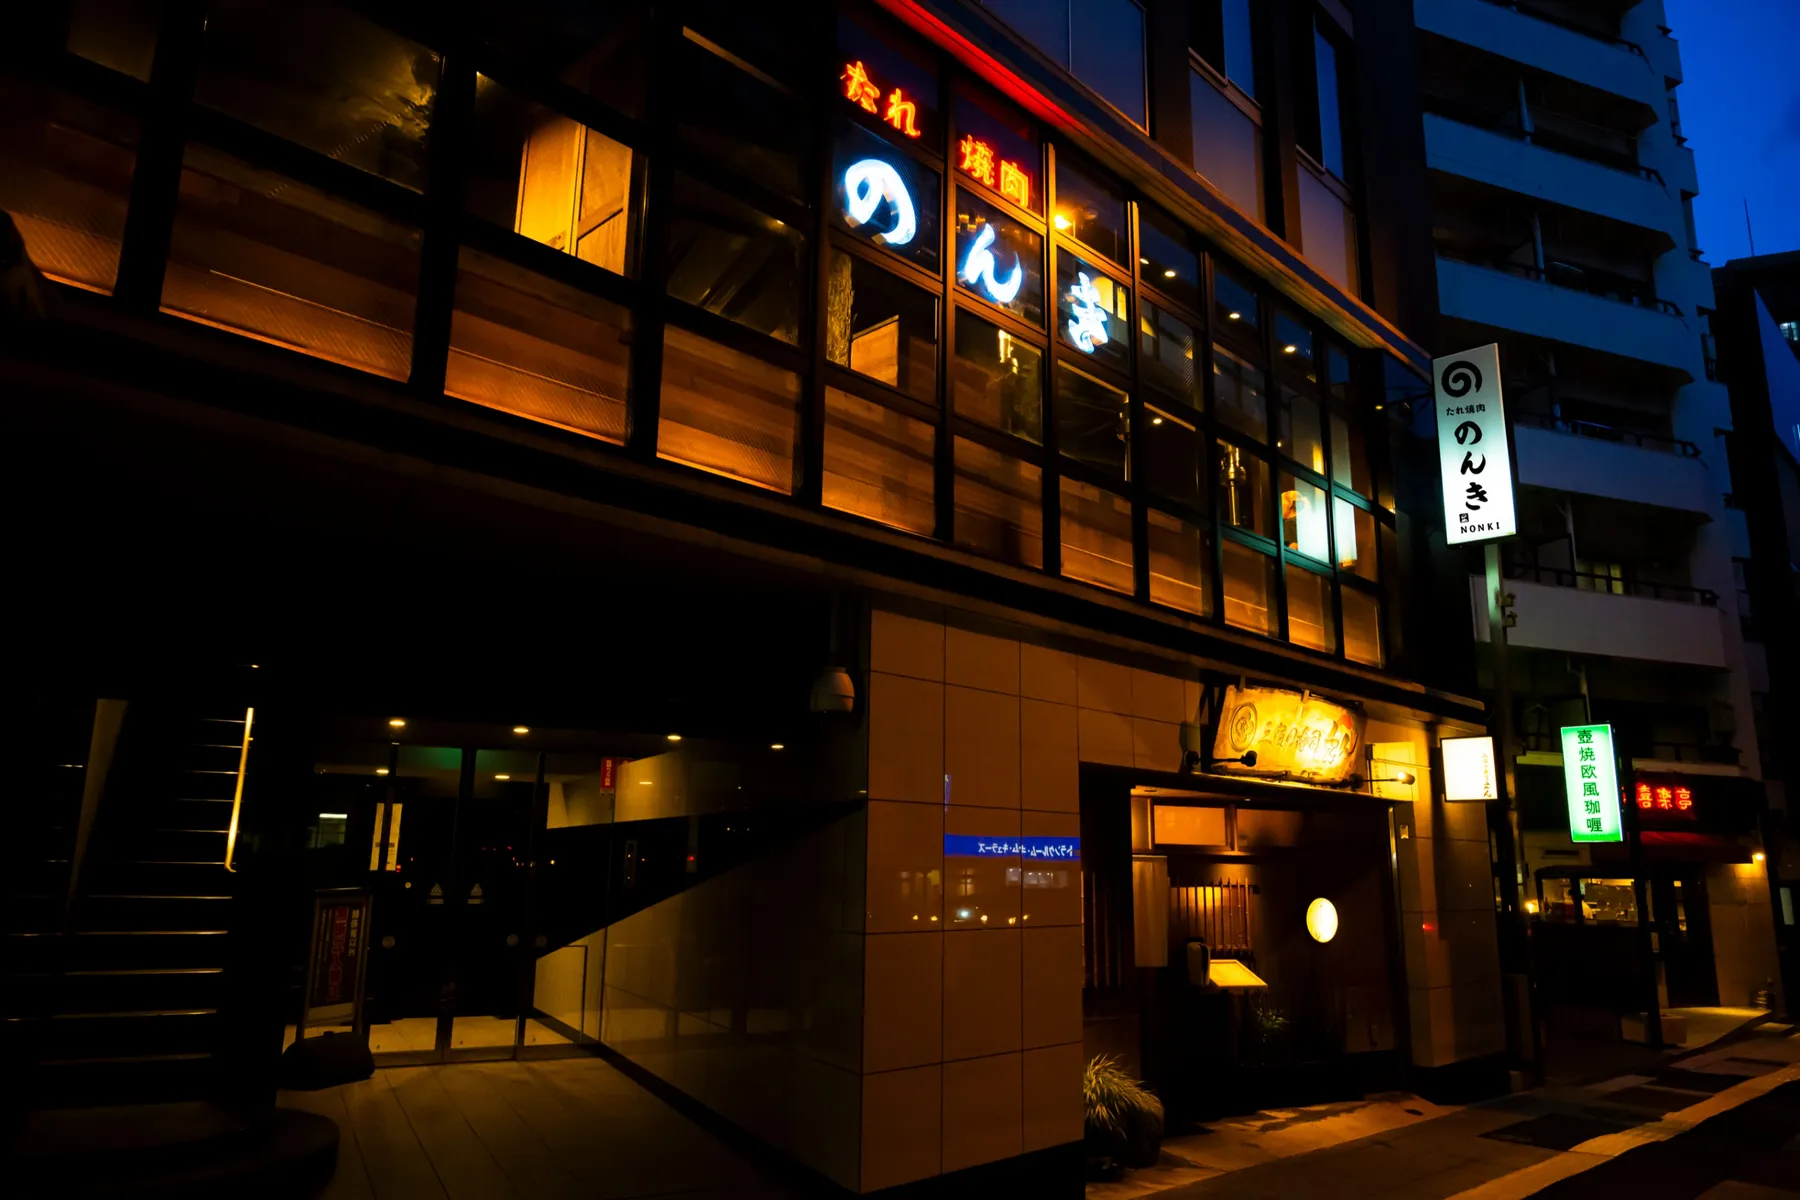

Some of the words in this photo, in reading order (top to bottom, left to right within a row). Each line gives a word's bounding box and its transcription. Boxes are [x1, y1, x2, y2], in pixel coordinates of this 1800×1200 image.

[1446, 403, 1486, 416] たれ焼肉
[1454, 420, 1488, 511] のんき
[1461, 522, 1500, 533] NONKI
[1637, 783, 1692, 810] 喜楽亭
